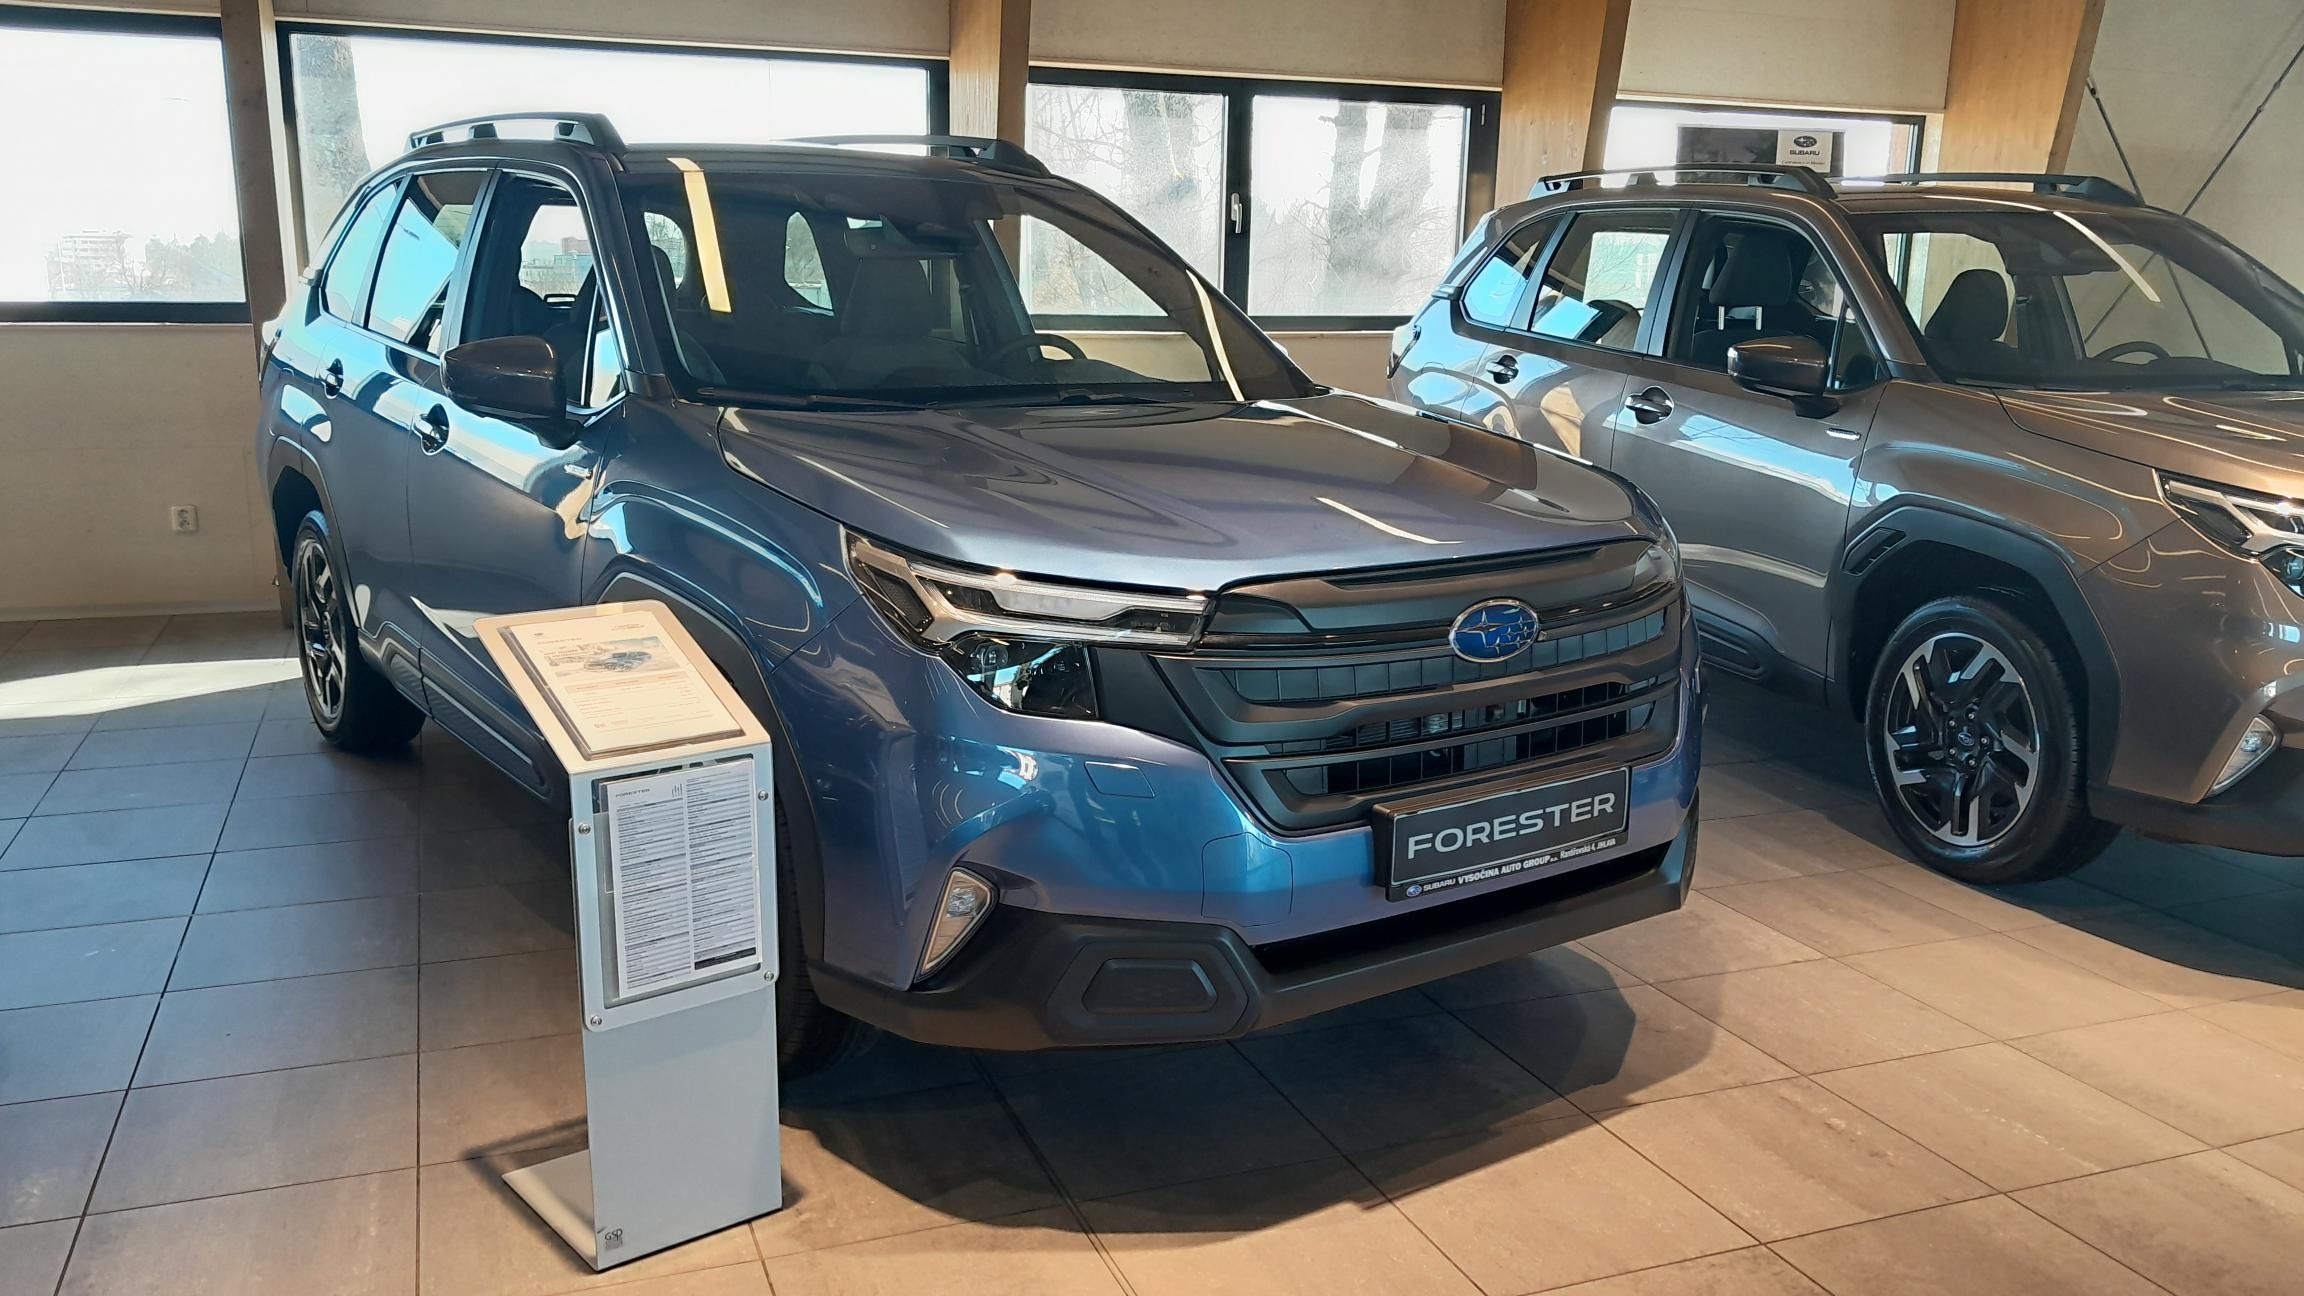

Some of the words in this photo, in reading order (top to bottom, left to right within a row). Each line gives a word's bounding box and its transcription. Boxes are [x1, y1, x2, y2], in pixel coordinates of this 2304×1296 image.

[1407, 792, 1616, 860] FORESTER
[1423, 878, 1456, 892] SUBARU
[1457, 868, 1500, 884] VYSOČINA
[1500, 862, 1522, 874] AUTO
[1522, 855, 1551, 869] GROUP
